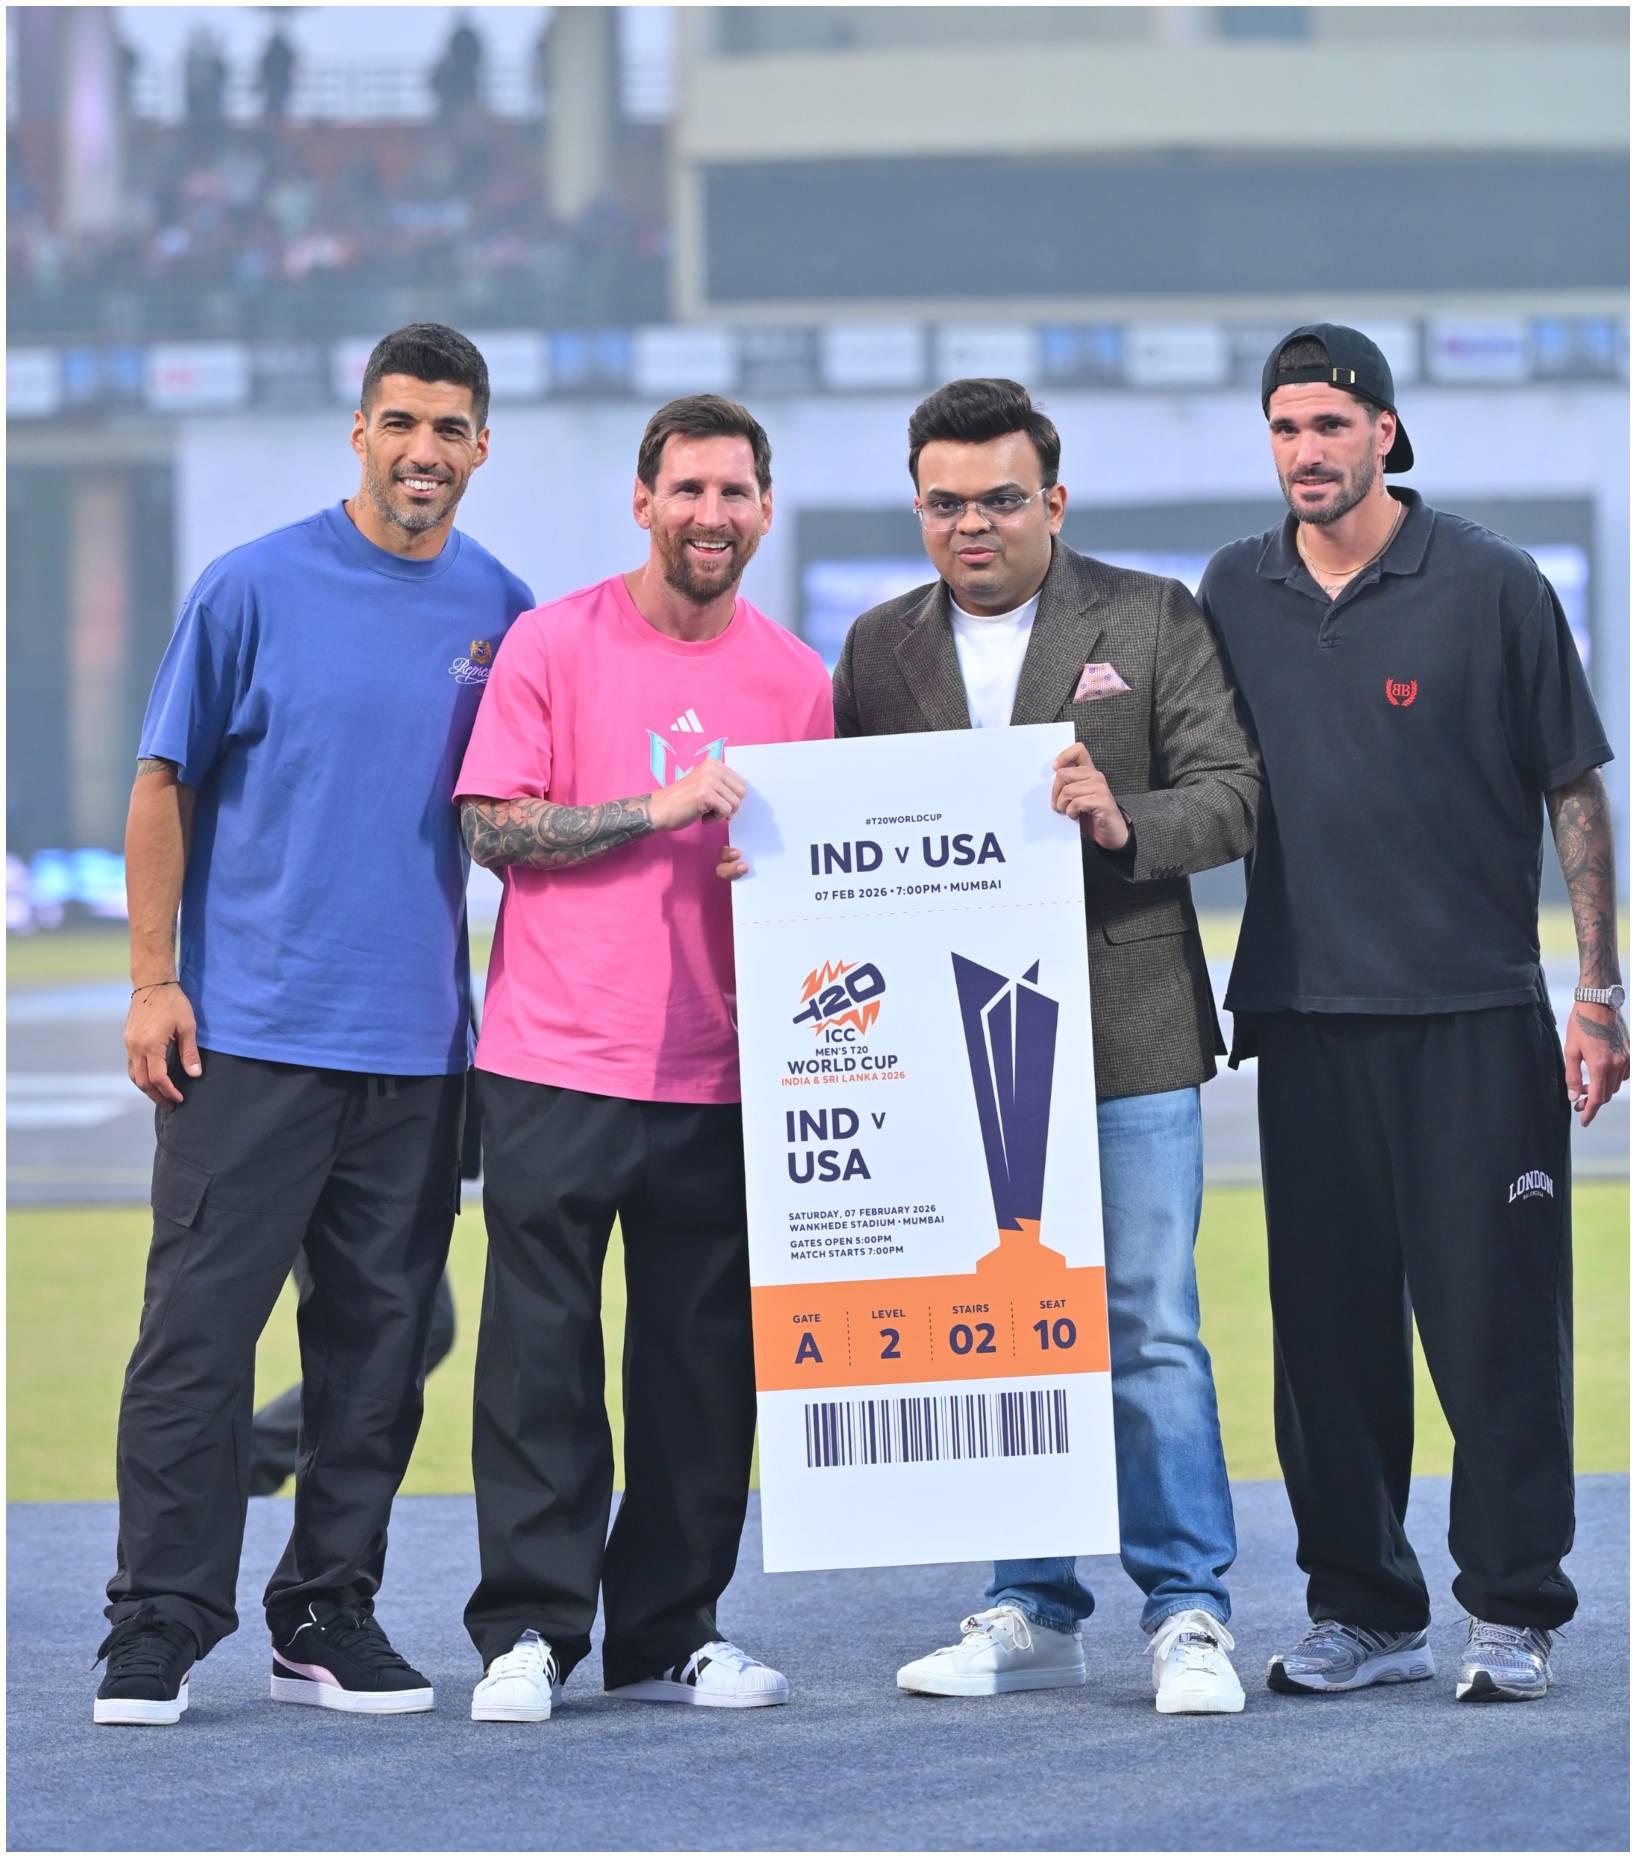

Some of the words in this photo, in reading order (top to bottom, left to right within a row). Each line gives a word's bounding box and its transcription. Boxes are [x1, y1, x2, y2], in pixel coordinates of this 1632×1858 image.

[865, 813, 943, 825] #T20WORLDCUP
[810, 840, 884, 876] IND
[922, 831, 1007, 868] USA
[814, 890, 829, 901] 07
[832, 890, 856, 899] FEB
[858, 887, 888, 899] 2026
[895, 883, 941, 896] 7:00PM
[949, 879, 1002, 892] MUMBAI
[825, 1028, 856, 1043] ICC
[815, 1046, 848, 1057] MEN'S
[850, 1046, 868, 1055] T20
[787, 1057, 856, 1075] WORLD
[861, 1055, 898, 1070] CUP
[781, 1077, 811, 1087] INDIA
[812, 1075, 821, 1085] &
[822, 1074, 839, 1084] SRI
[841, 1073, 878, 1083] LANKA
[881, 1071, 906, 1080] 2026
[785, 1107, 860, 1143] IND
[787, 1148, 872, 1184] USA
[1507, 1169, 1554, 1203] LONDON
[788, 1209, 842, 1221] SATURDAY,
[844, 1209, 856, 1218] 07
[860, 1206, 910, 1216] FEBRUARY
[912, 1204, 937, 1214] 2026
[789, 1220, 849, 1233] WANKHEDE
[851, 1219, 896, 1229] STADIUM
[902, 1215, 945, 1226] MUMBAI
[789, 1238, 823, 1249] GATES
[824, 1236, 853, 1247] OPEN
[855, 1234, 892, 1245] 5:00PM
[791, 1250, 825, 1260] MATCH
[828, 1247, 866, 1258] STARTS
[867, 1245, 904, 1255] 7:00PM
[952, 1303, 990, 1315] STAIRS
[1039, 1299, 1067, 1310] SEAT
[792, 1313, 822, 1324] GATE
[871, 1308, 907, 1320] LEVEL
[948, 1322, 997, 1356] 02
[1032, 1317, 1077, 1351] 10
[794, 1332, 824, 1365] A
[879, 1327, 902, 1360] 2
